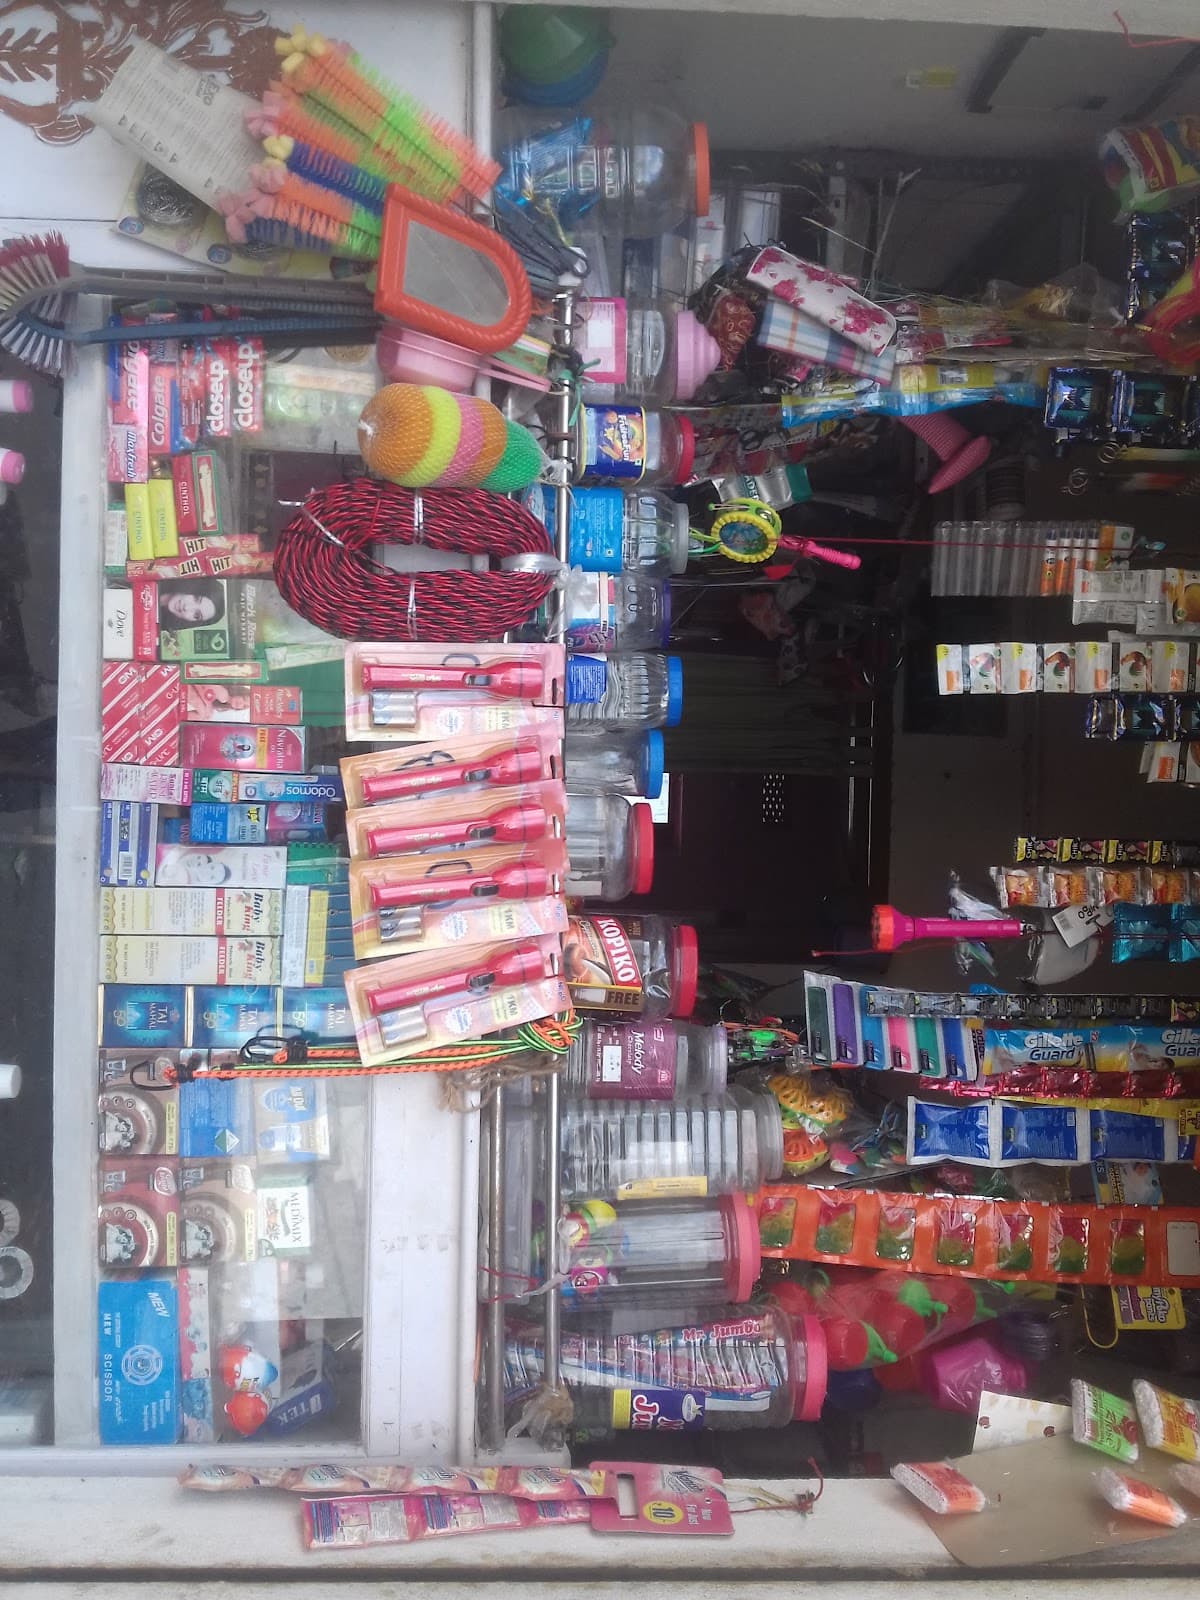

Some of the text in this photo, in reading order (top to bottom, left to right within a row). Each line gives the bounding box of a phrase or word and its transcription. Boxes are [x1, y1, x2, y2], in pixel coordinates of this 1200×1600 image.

[124, 338, 140, 410] olgate
[233, 343, 260, 428] closeup
[206, 359, 230, 432] closeup
[152, 374, 166, 446] Colgate
[180, 481, 190, 516] CINTHOL
[184, 538, 206, 554] HIT
[180, 560, 200, 575] HIT
[212, 556, 231, 572] HIT
[116, 609, 129, 638] Dove
[246, 584, 256, 650] Black Rose
[276, 729, 286, 768] Navratna
[286, 786, 336, 798] Odomos
[216, 896, 224, 926] FEEDER
[253, 892, 264, 923] Baby
[504, 908, 515, 930] 1KM
[218, 946, 226, 975] FEEDER
[254, 941, 265, 971] Baby
[596, 918, 637, 982] KOPIKO
[506, 994, 518, 1016] 1KM
[608, 992, 640, 1006] FREE
[148, 1002, 156, 1030] MAHAL
[156, 1006, 168, 1024] TAJ
[247, 1008, 258, 1025] TAJ
[327, 1003, 335, 1030] MAHAL
[335, 1008, 346, 1024] TAJ
[631, 1031, 645, 1076] Melody
[1024, 1033, 1084, 1049] Gillette
[1029, 1050, 1076, 1061] Guard
[290, 1192, 302, 1243] MEDIMIX
[148, 1292, 170, 1318] MEW
[1120, 1299, 1129, 1312] XL
[710, 1320, 760, 1338] Jumbo
[104, 1313, 112, 1402] MEW SCISSOR
[686, 1504, 699, 1525] For Just
